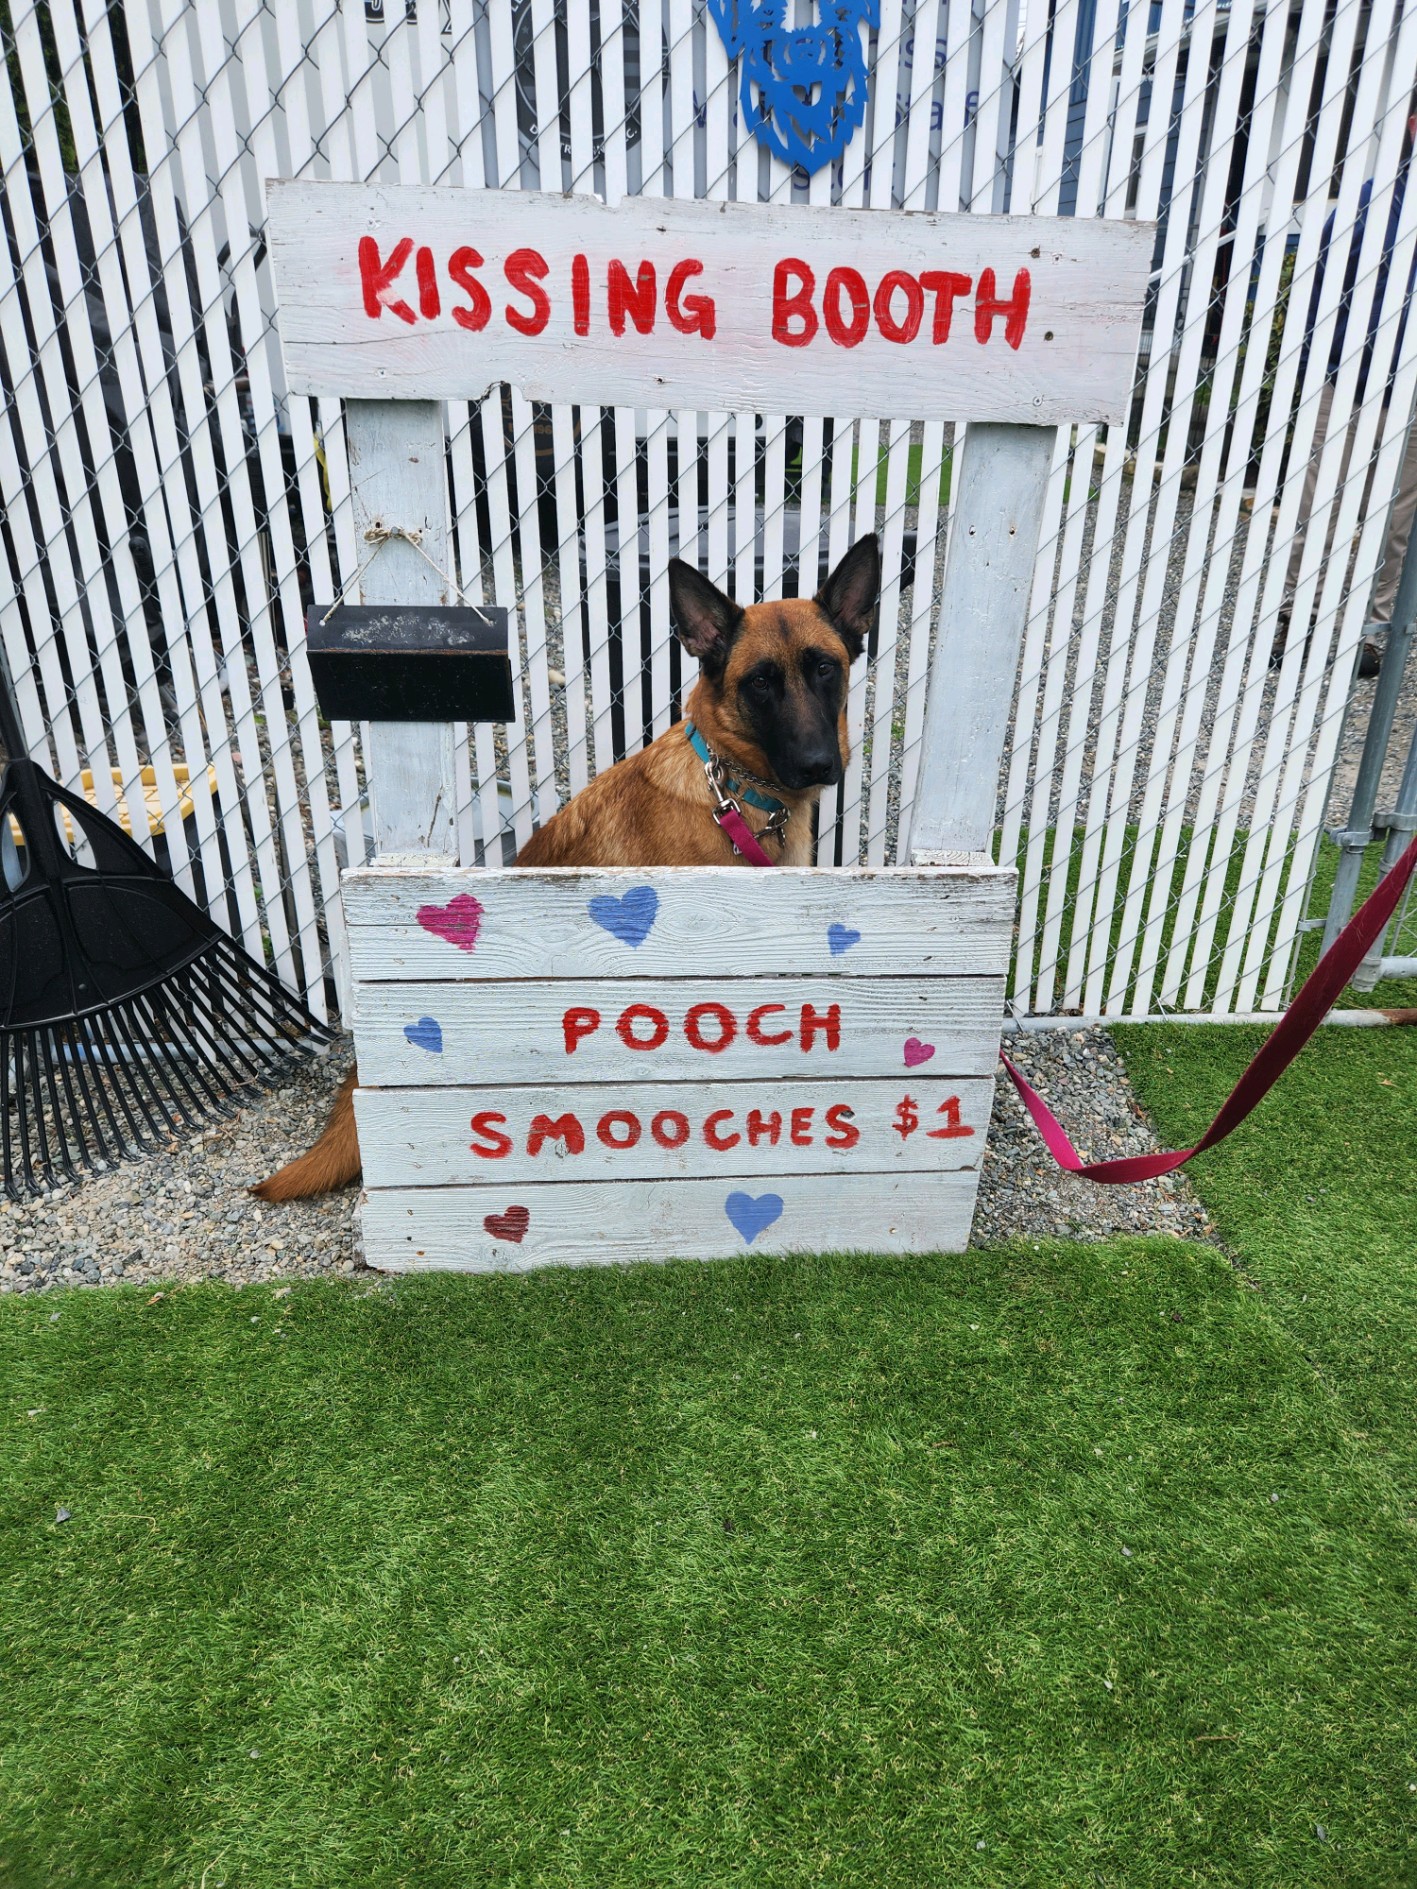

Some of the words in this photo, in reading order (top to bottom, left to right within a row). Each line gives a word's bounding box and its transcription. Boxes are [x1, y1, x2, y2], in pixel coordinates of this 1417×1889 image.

[358, 235, 717, 340] KISSING
[772, 258, 1031, 350] BOOTH
[562, 1002, 842, 1053] POOCH
[470, 1104, 861, 1159] SMOOCHES
[892, 1094, 974, 1140] $1
